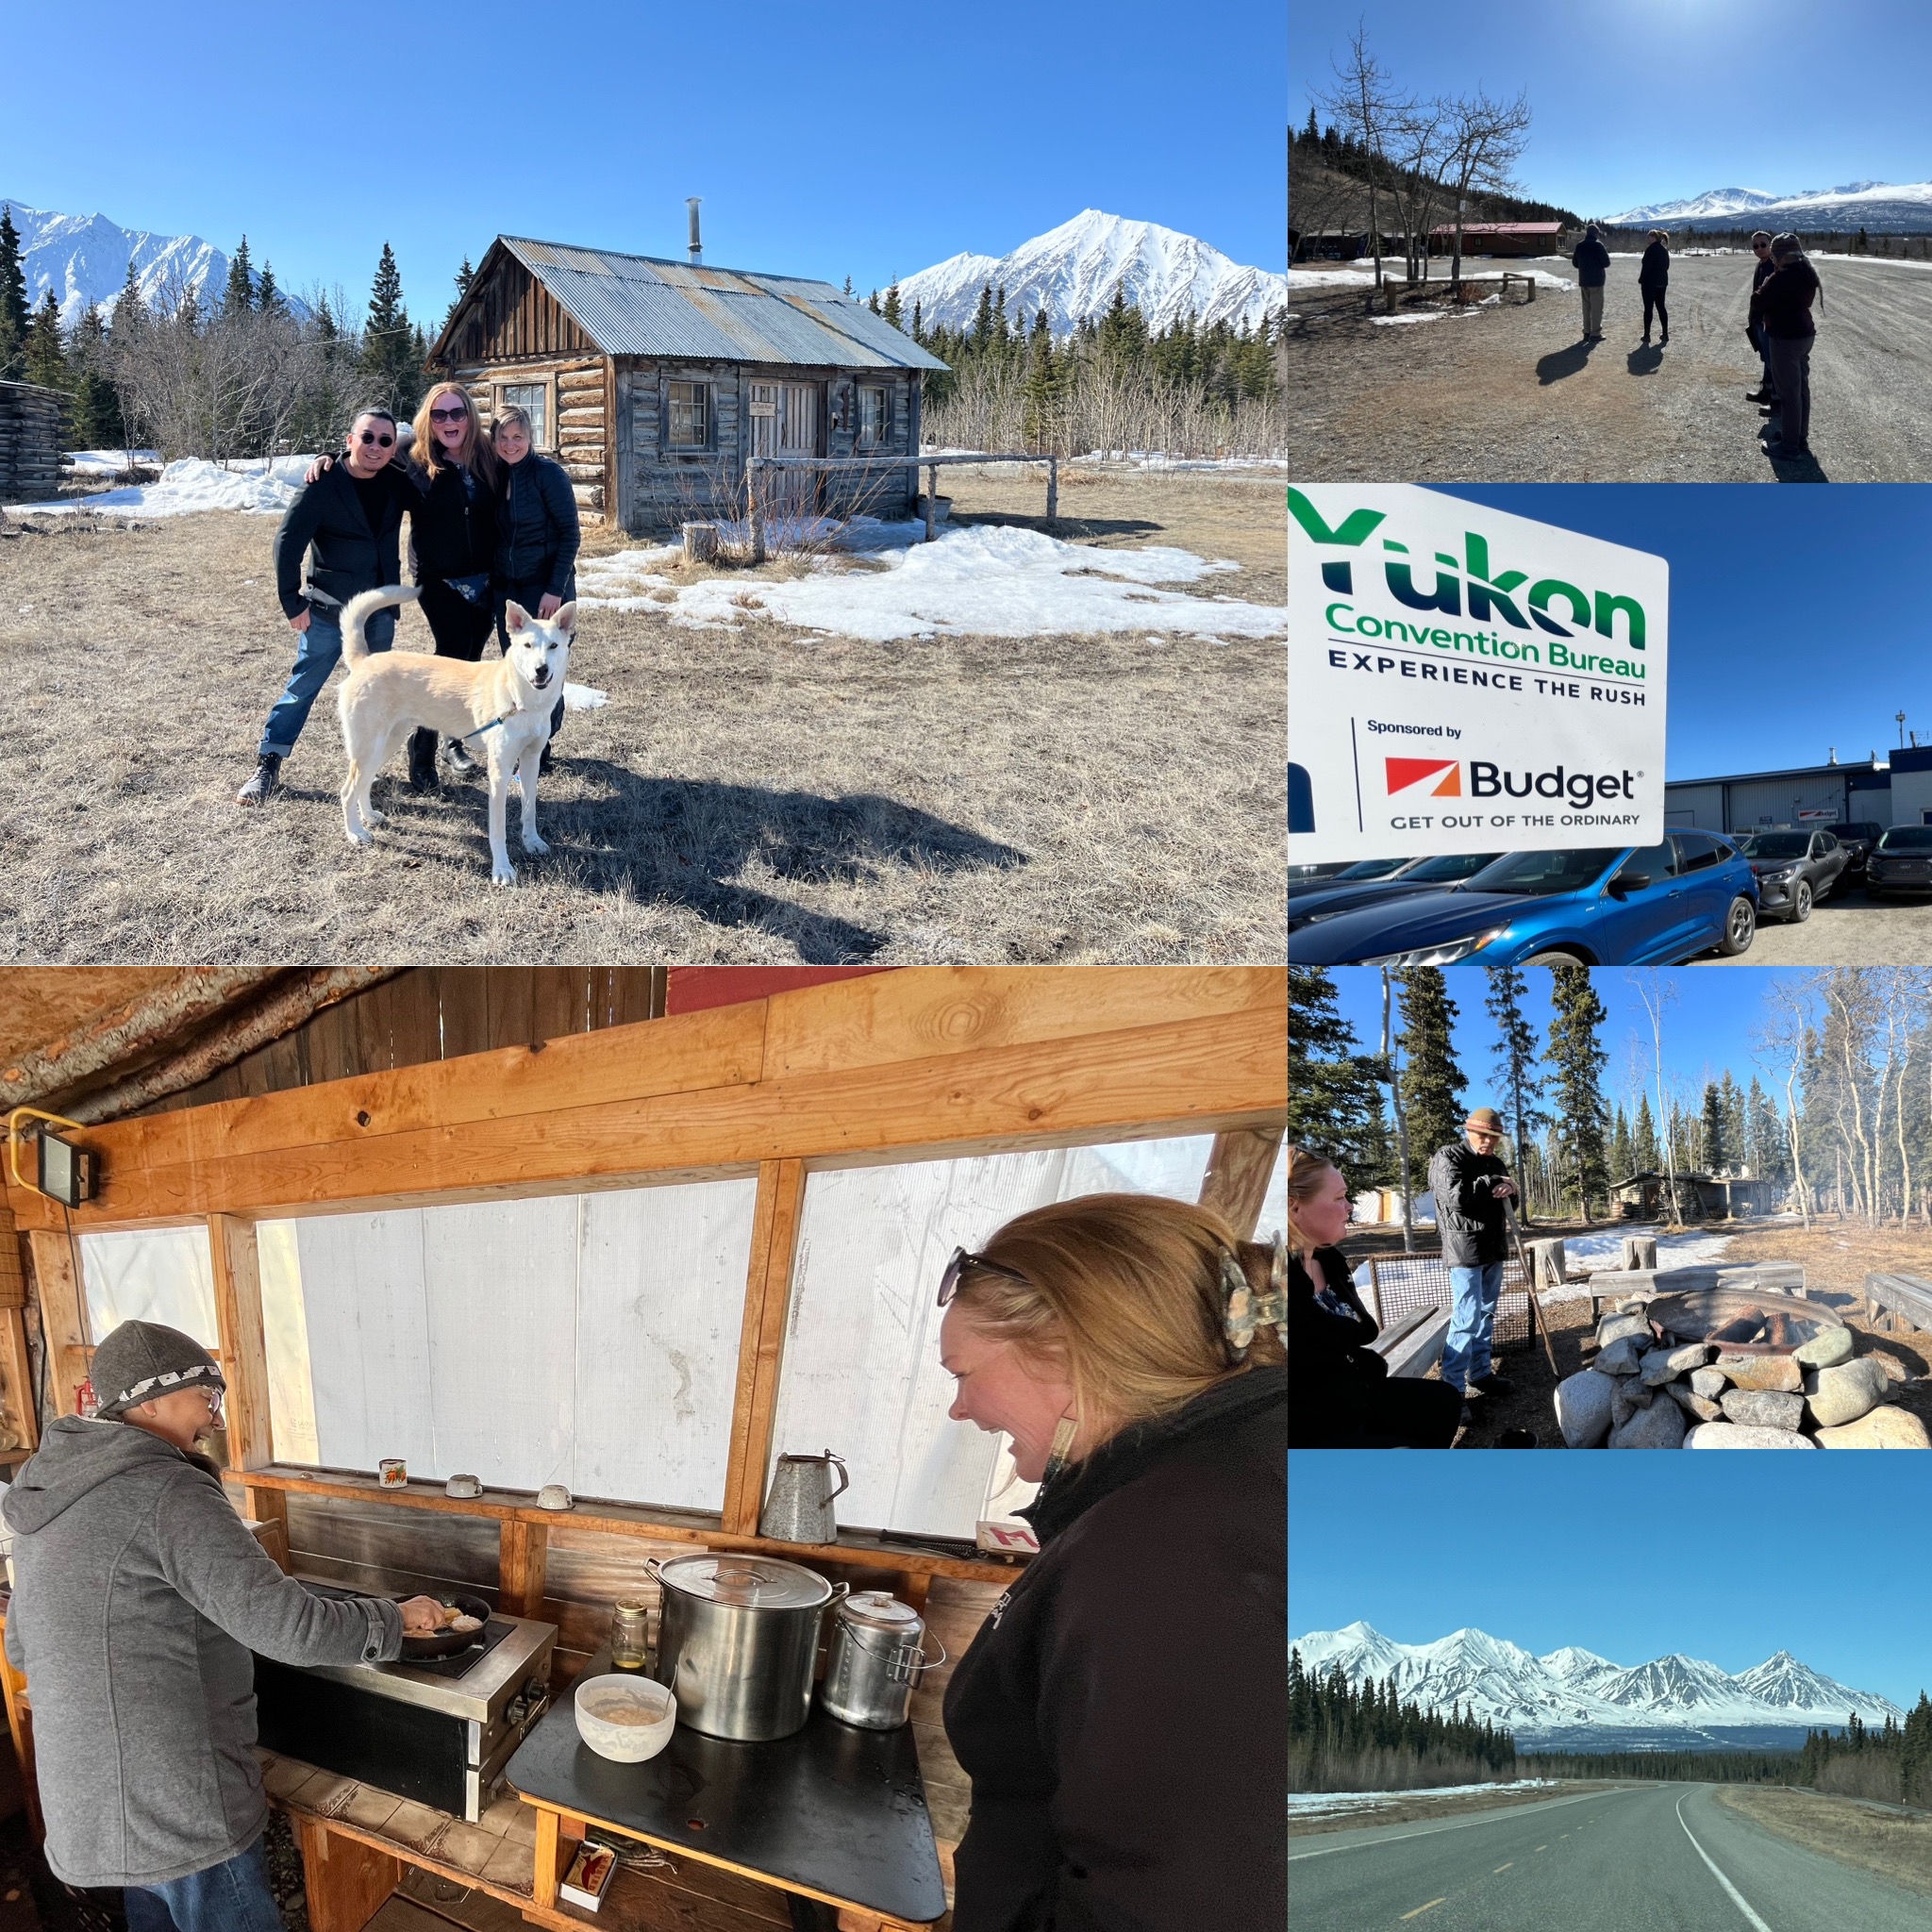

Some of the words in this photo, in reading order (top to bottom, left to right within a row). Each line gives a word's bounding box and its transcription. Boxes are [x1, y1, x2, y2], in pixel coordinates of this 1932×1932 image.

[1288, 486, 1645, 650] Yukon
[1325, 603, 1539, 663] Convention
[1548, 641, 1645, 678] Bureau
[1328, 649, 1523, 691] EXPERIENCE
[1534, 678, 1580, 698] THE
[1591, 686, 1645, 707] RUSH
[1367, 719, 1442, 737] Sponsored
[1446, 725, 1461, 740] by
[1391, 816, 1434, 829] GET
[1441, 816, 1484, 828] OUT
[1491, 815, 1515, 827] OF
[1522, 815, 1555, 826] THE
[1560, 814, 1641, 826] ORDINARY
